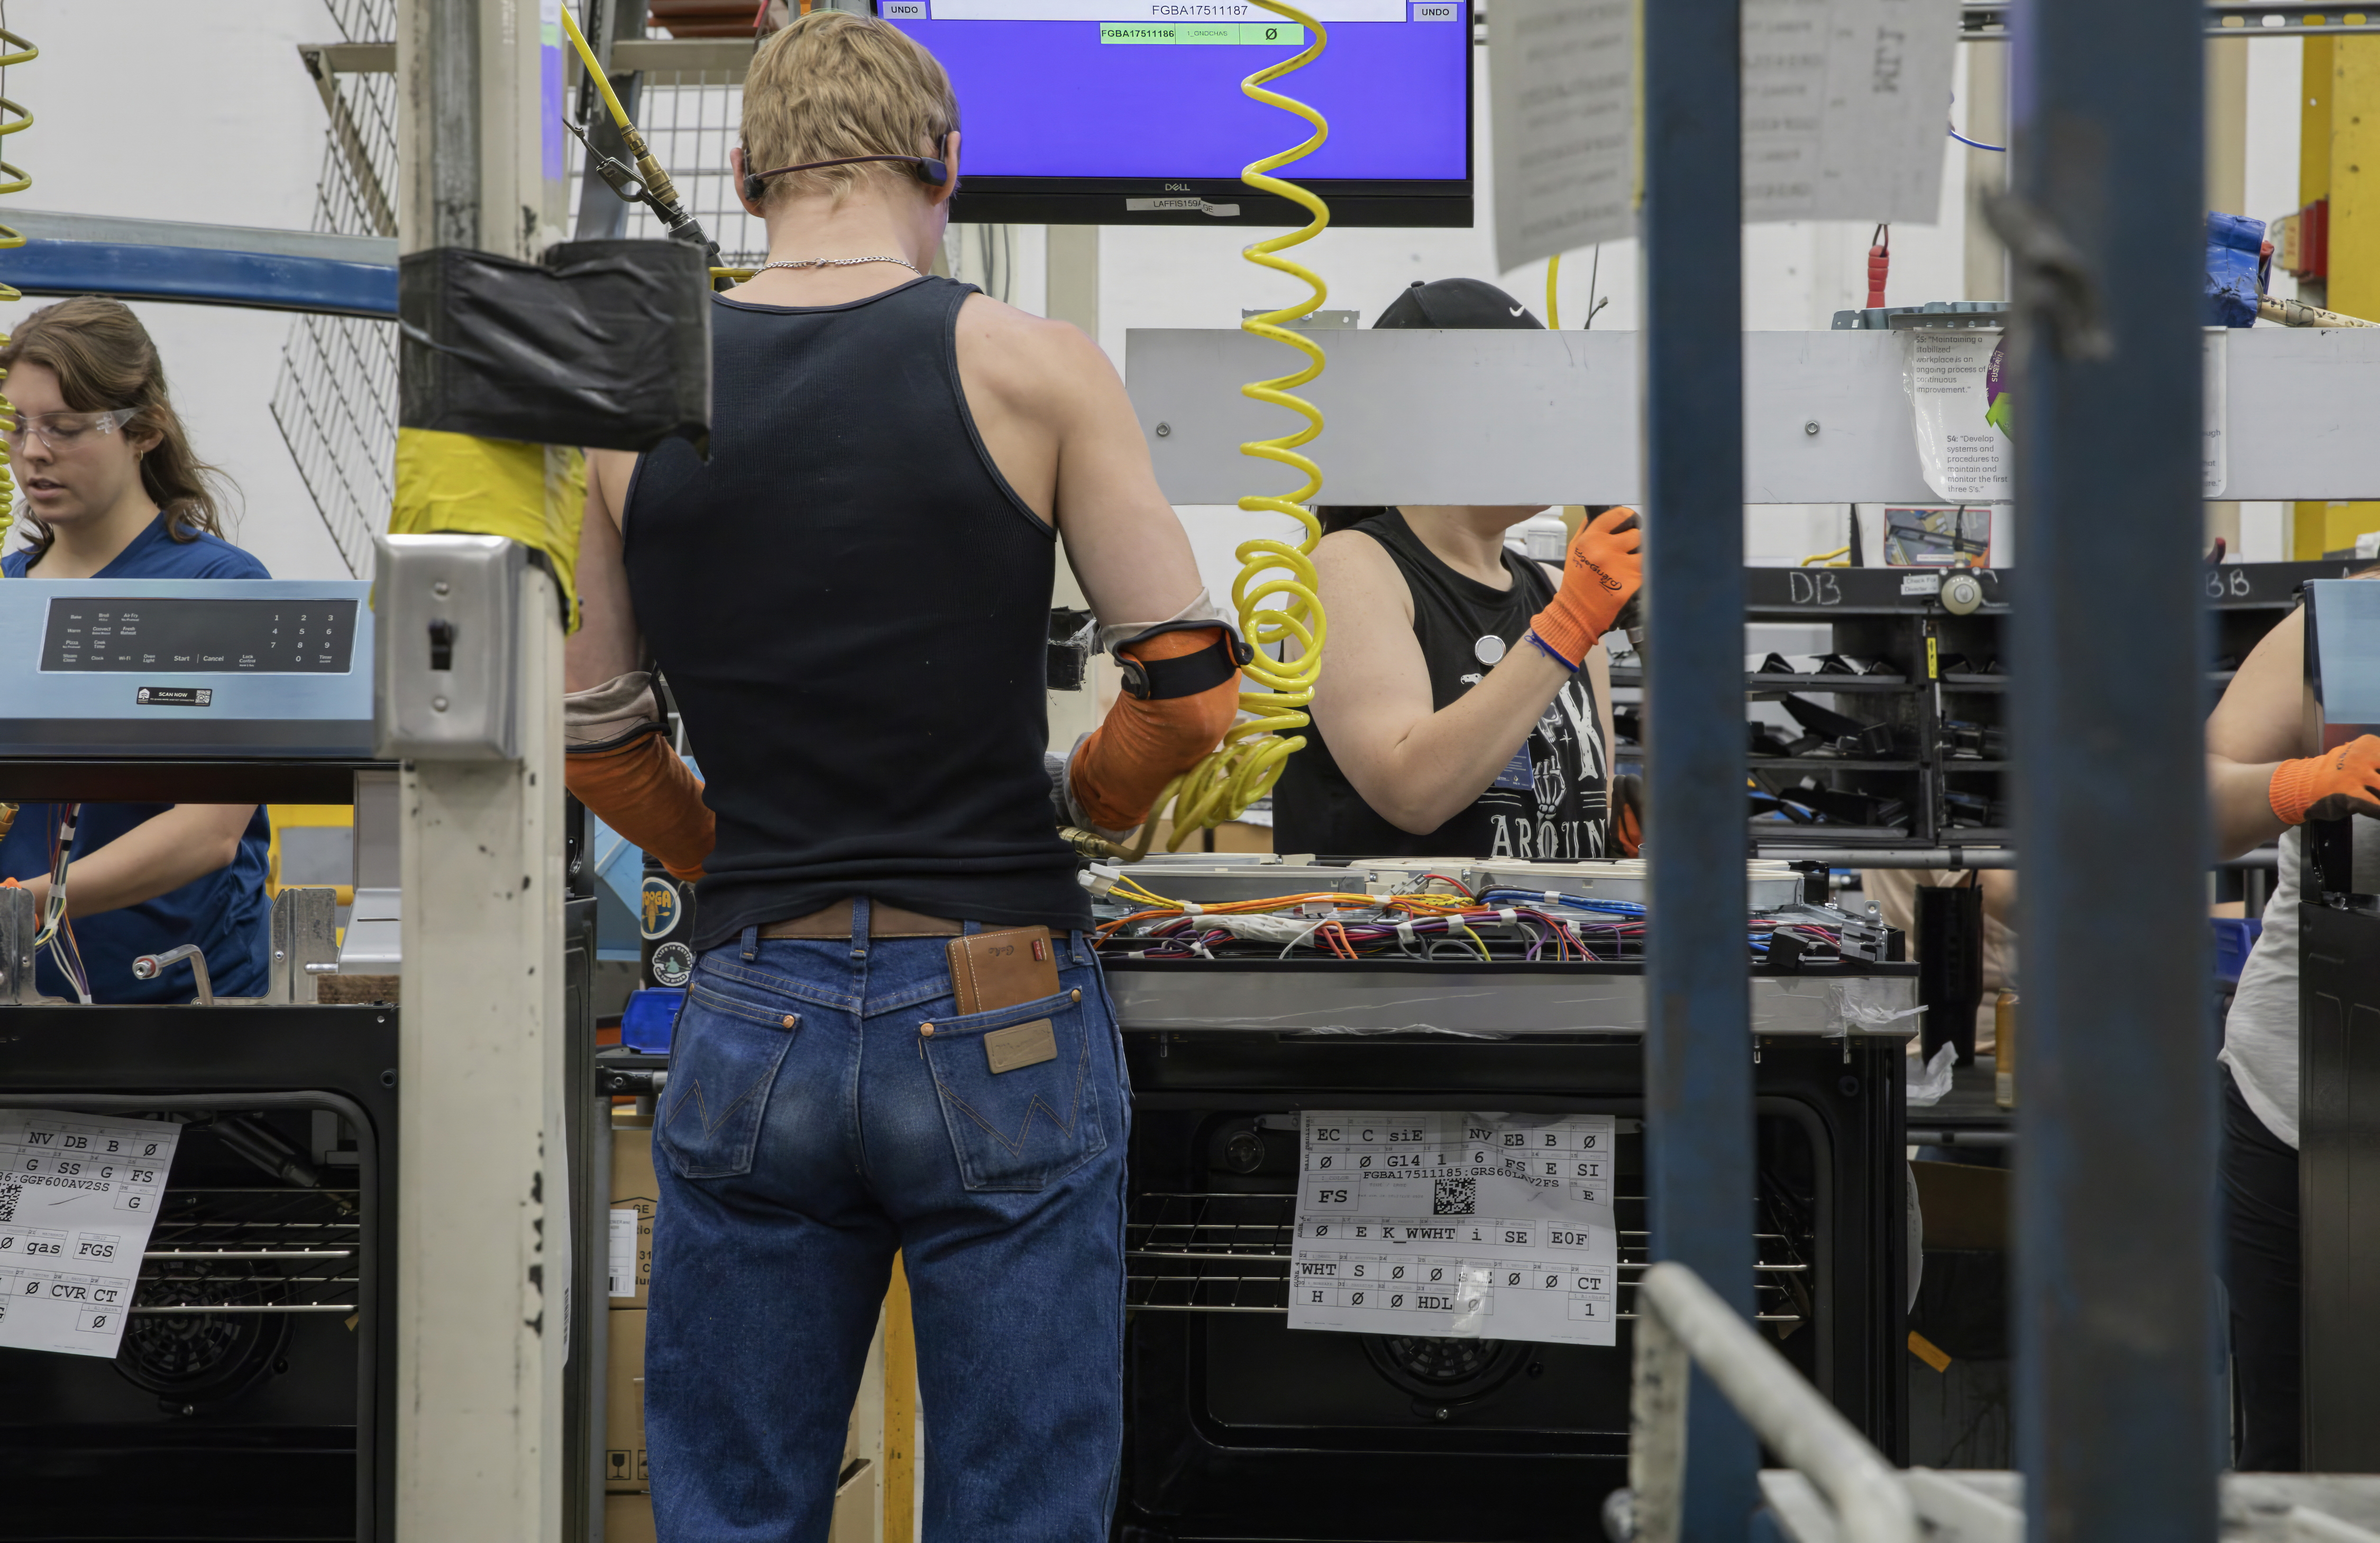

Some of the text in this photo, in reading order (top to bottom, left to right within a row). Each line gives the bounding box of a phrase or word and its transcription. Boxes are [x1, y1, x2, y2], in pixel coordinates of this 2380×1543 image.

[1152, 5, 1248, 15] FGBA17511187
[1790, 571, 1842, 605] DB
[29, 1132, 54, 1145] NV
[64, 1136, 87, 1148] DB
[107, 1140, 119, 1152] B
[1317, 1129, 1340, 1141] EC
[1362, 1129, 1374, 1142] C
[1389, 1129, 1423, 1142] siE
[1469, 1129, 1493, 1140] NV
[1504, 1134, 1524, 1146] EB
[1545, 1134, 1557, 1146] B
[26, 1159, 153, 1183] G SS G FS
[1387, 1155, 1420, 1167] G14
[1438, 1154, 1447, 1165] 1
[1475, 1152, 1484, 1163] 6
[1505, 1158, 1526, 1172] FS
[1546, 1163, 1557, 1175] E
[1578, 1164, 1599, 1176] SI
[129, 1197, 141, 1209] G
[1319, 1190, 1348, 1203] FS
[1583, 1190, 1594, 1201] E
[1356, 1227, 1367, 1237] E
[1472, 1228, 1482, 1240] i
[1505, 1231, 1527, 1244] SE
[27, 1242, 61, 1255] gas
[79, 1243, 113, 1257] FGS
[1301, 1263, 1337, 1275] WHT
[1354, 1265, 1365, 1277] S
[1578, 1277, 1601, 1290] CT
[52, 1284, 86, 1300] CVR
[94, 1289, 117, 1302] CT
[1312, 1291, 1323, 1303] H
[1417, 1296, 1453, 1310] HDL
[1585, 1303, 1595, 1316] 1
